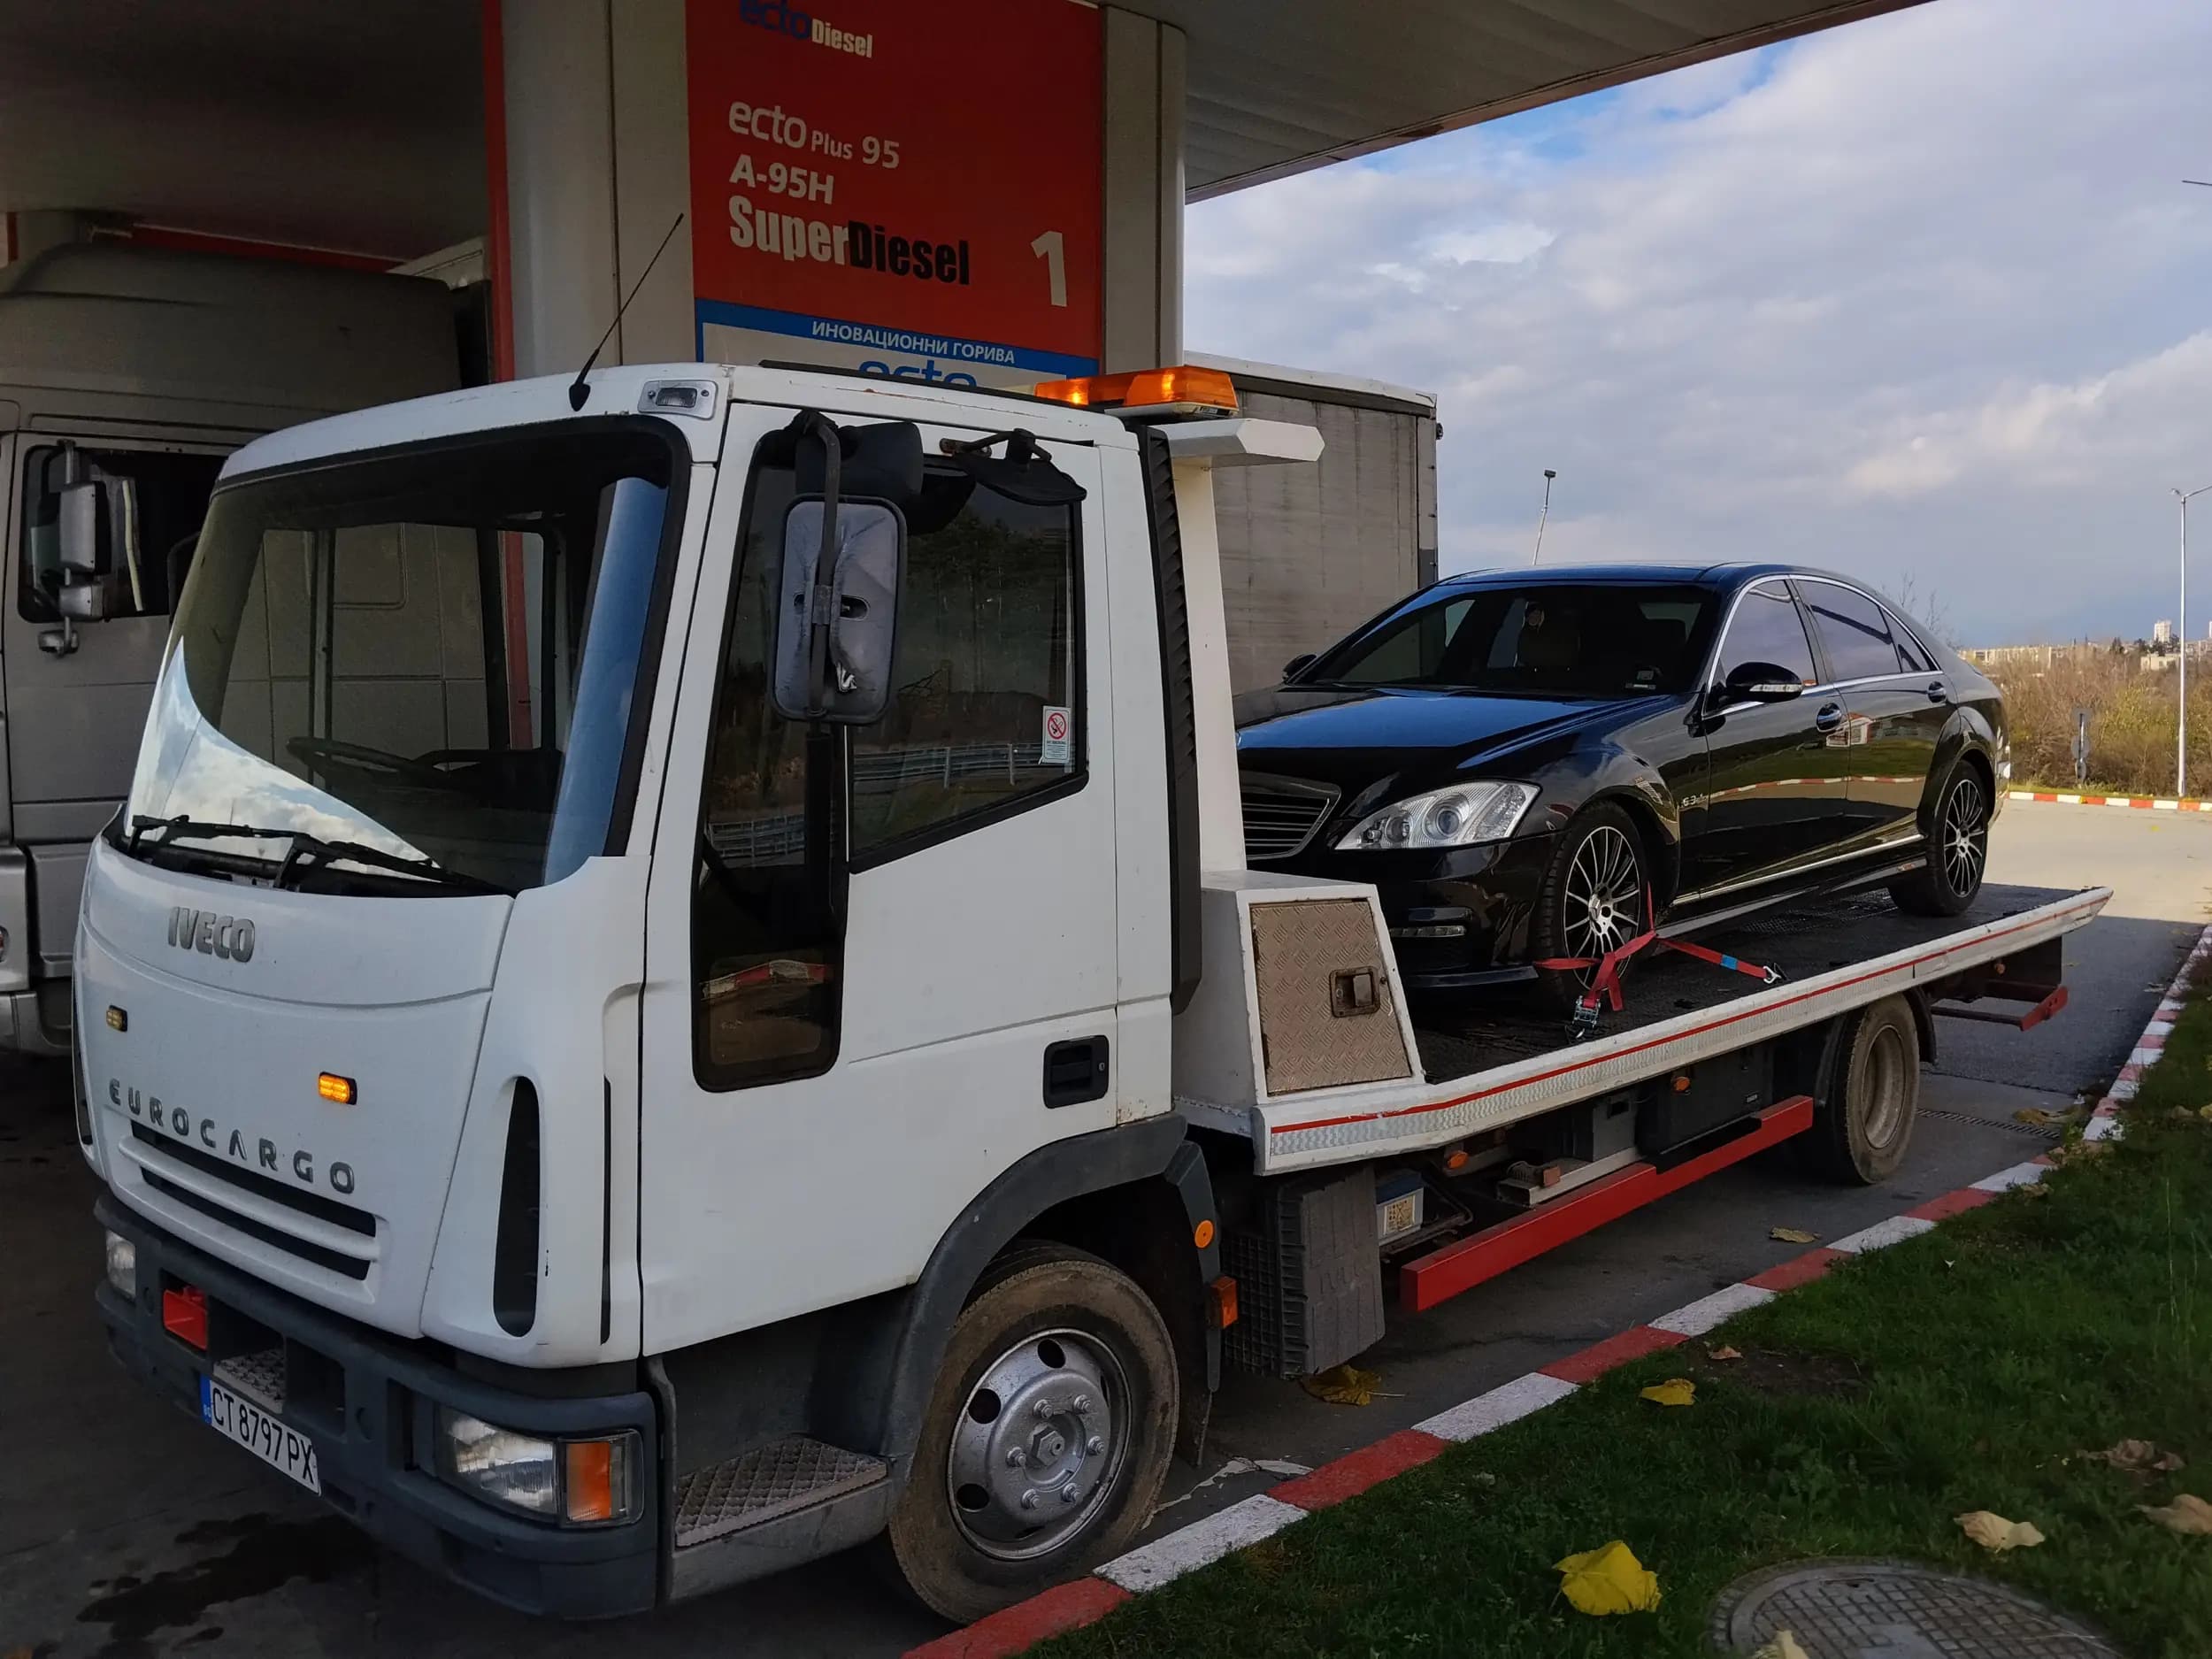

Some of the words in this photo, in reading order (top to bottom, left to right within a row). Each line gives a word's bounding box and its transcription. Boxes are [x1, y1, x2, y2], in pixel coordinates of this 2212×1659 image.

[729, 101, 807, 149] ecto
[811, 130, 853, 160] Plus
[862, 136, 900, 169] 95
[729, 154, 834, 204] A-95H
[729, 196, 970, 285] SuperDiesel
[1031, 231, 1067, 307] 1
[812, 321, 948, 354] ИНОВАЦИОННИ
[953, 342, 1015, 364] ГОРИВА
[168, 906, 255, 963] IVECO
[109, 1078, 355, 1194] EUROCARGO
[239, 1403, 282, 1461] 8797
[287, 1432, 314, 1485] PX
